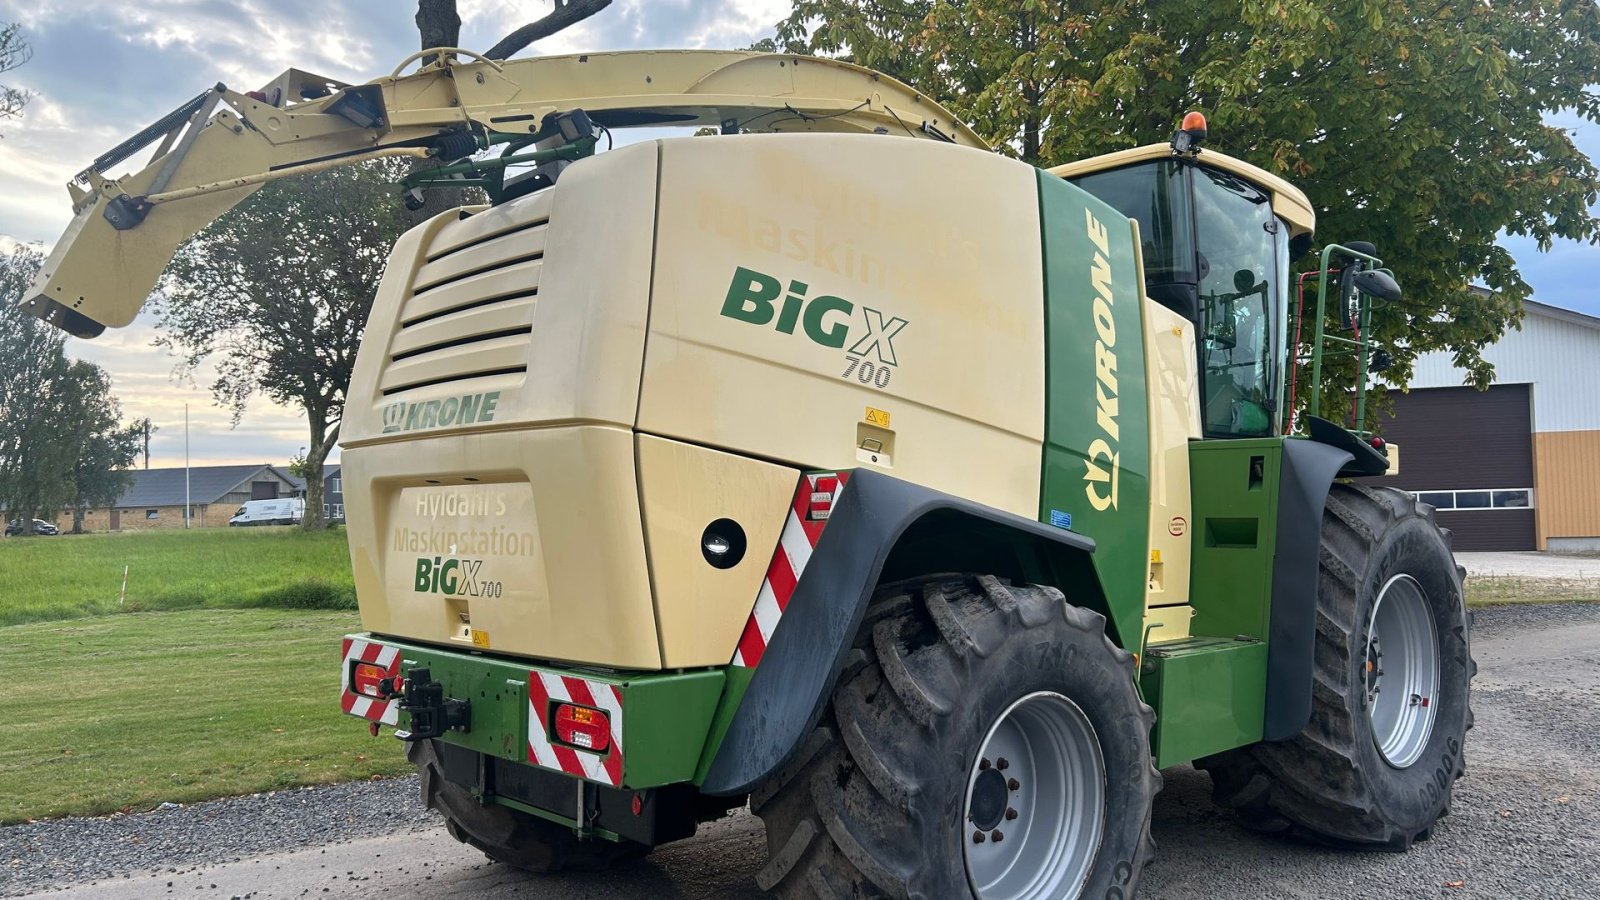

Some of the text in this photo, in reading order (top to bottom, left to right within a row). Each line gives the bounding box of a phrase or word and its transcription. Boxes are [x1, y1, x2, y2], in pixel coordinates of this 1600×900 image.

[1085, 207, 1119, 442] KRONE
[842, 355, 891, 389] 700
[405, 392, 500, 430] KRONE
[394, 525, 534, 556] Maskinstation
[480, 581, 502, 599] 700
